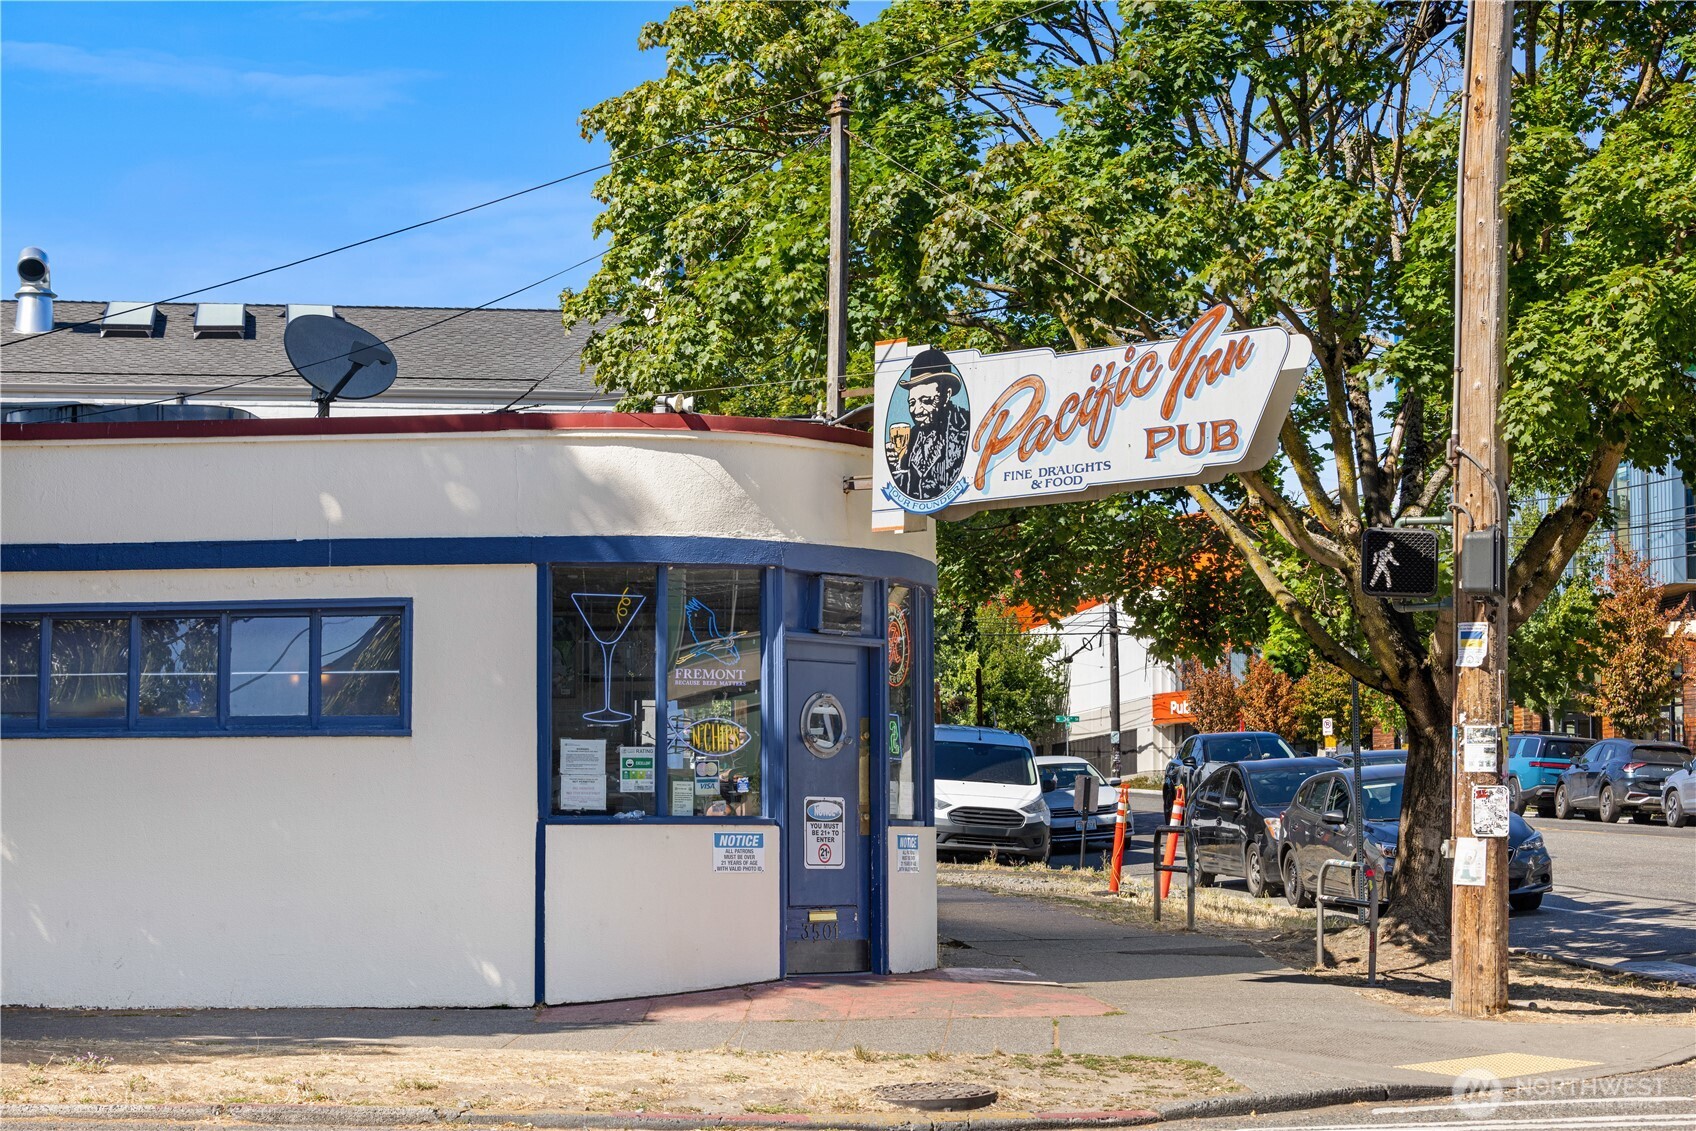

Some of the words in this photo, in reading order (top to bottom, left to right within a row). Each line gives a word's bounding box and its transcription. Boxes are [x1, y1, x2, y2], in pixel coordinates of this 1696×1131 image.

[972, 346, 1163, 491] Pacific
[1160, 303, 1256, 421] Inn
[1144, 418, 1239, 460] PUB
[1003, 469, 1032, 482] FINE
[1038, 460, 1112, 478] DRAUGHTS
[1031, 479, 1042, 490] &
[1045, 475, 1083, 488] FOOD
[892, 490, 910, 508] OUR
[912, 485, 961, 511] FOUNDER
[674, 668, 746, 680] FREMONT
[719, 834, 760, 847] NOTICE
[820, 847, 830, 857] 21+
[800, 922, 839, 941] 3501
